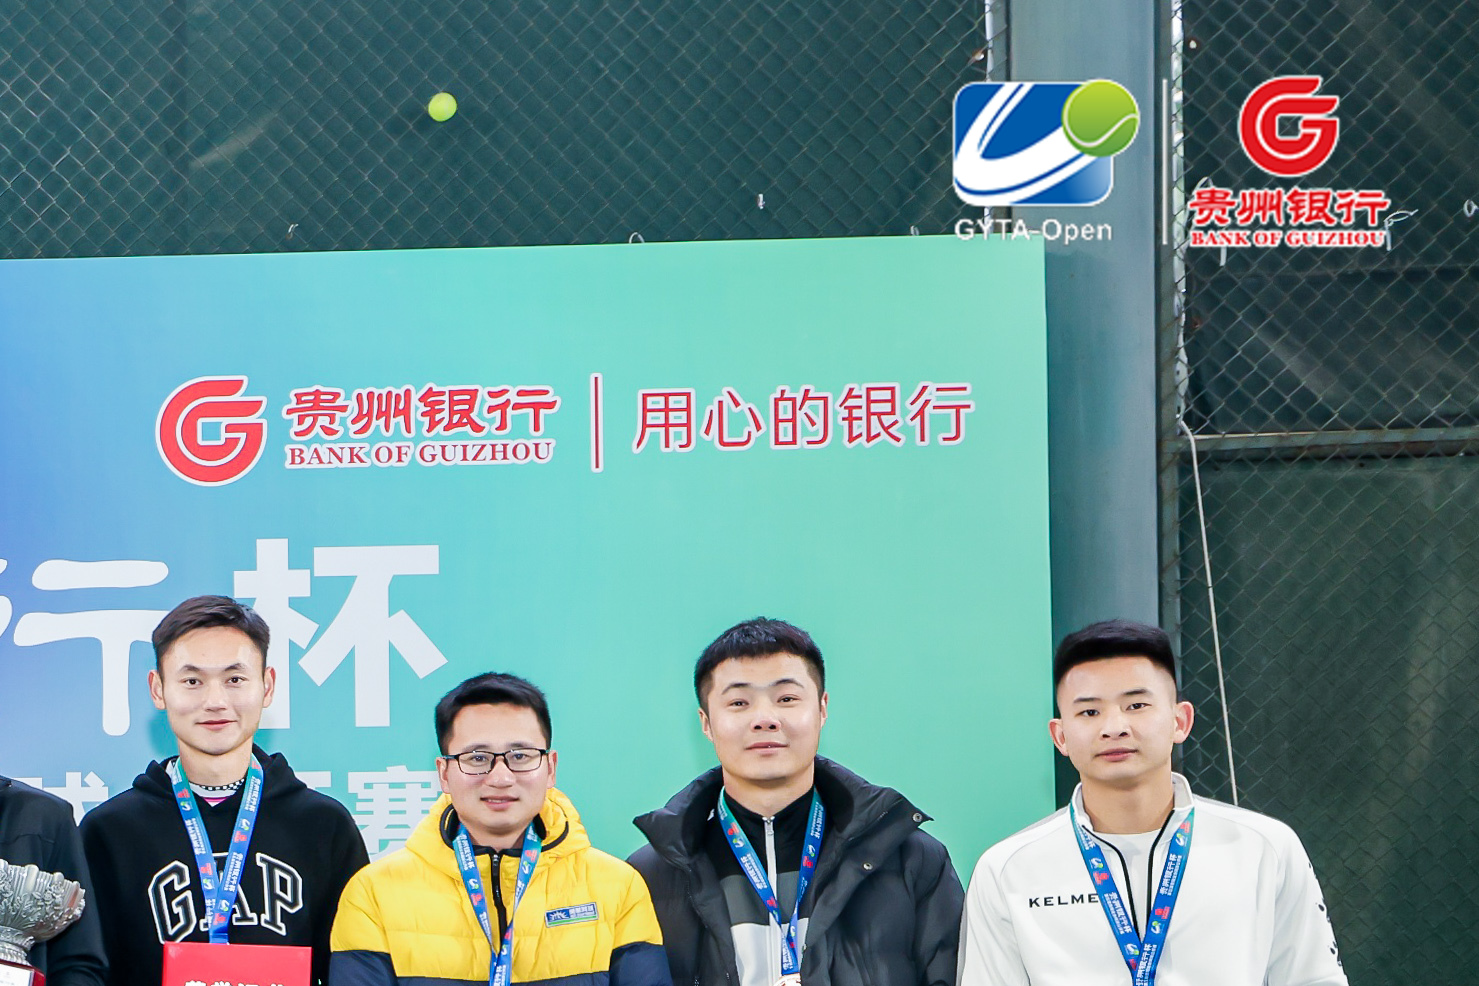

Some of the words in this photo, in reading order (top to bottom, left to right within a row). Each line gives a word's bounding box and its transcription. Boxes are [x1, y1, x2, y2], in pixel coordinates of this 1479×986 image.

[285, 385, 560, 440] 贵州银行
[633, 381, 975, 451] 用心的银行
[288, 445, 367, 467] BANK
[374, 444, 411, 466] OF
[418, 441, 554, 465] GUIZHOU
[1030, 894, 1099, 908] KELME
